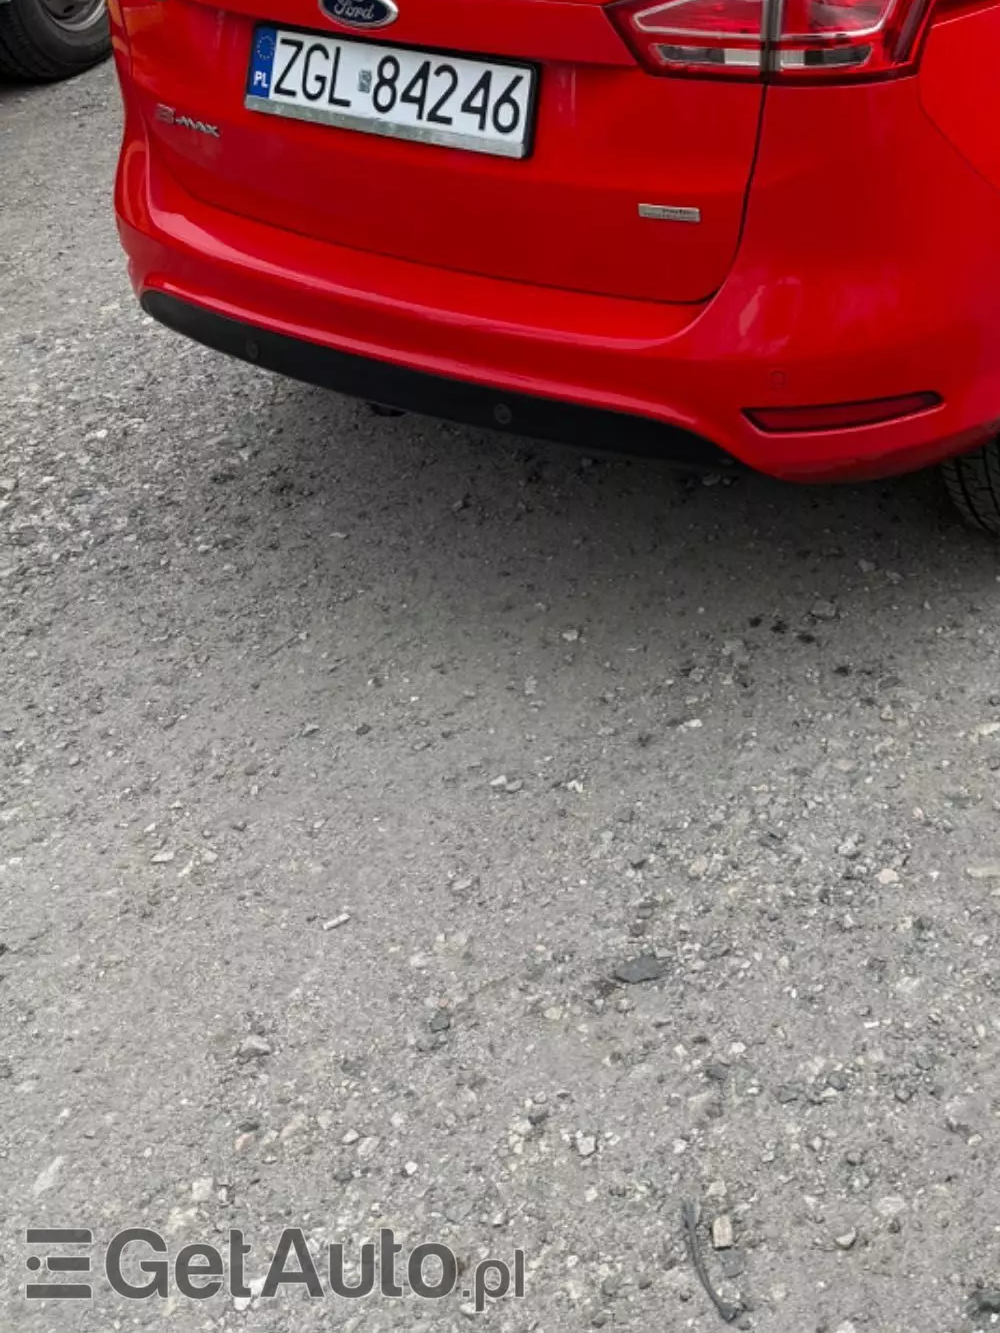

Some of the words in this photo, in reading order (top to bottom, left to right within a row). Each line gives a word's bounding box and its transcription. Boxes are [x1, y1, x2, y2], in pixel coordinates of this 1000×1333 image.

[253, 70, 268, 89] PL
[274, 38, 351, 108] ZGL
[372, 54, 524, 134] 84246
